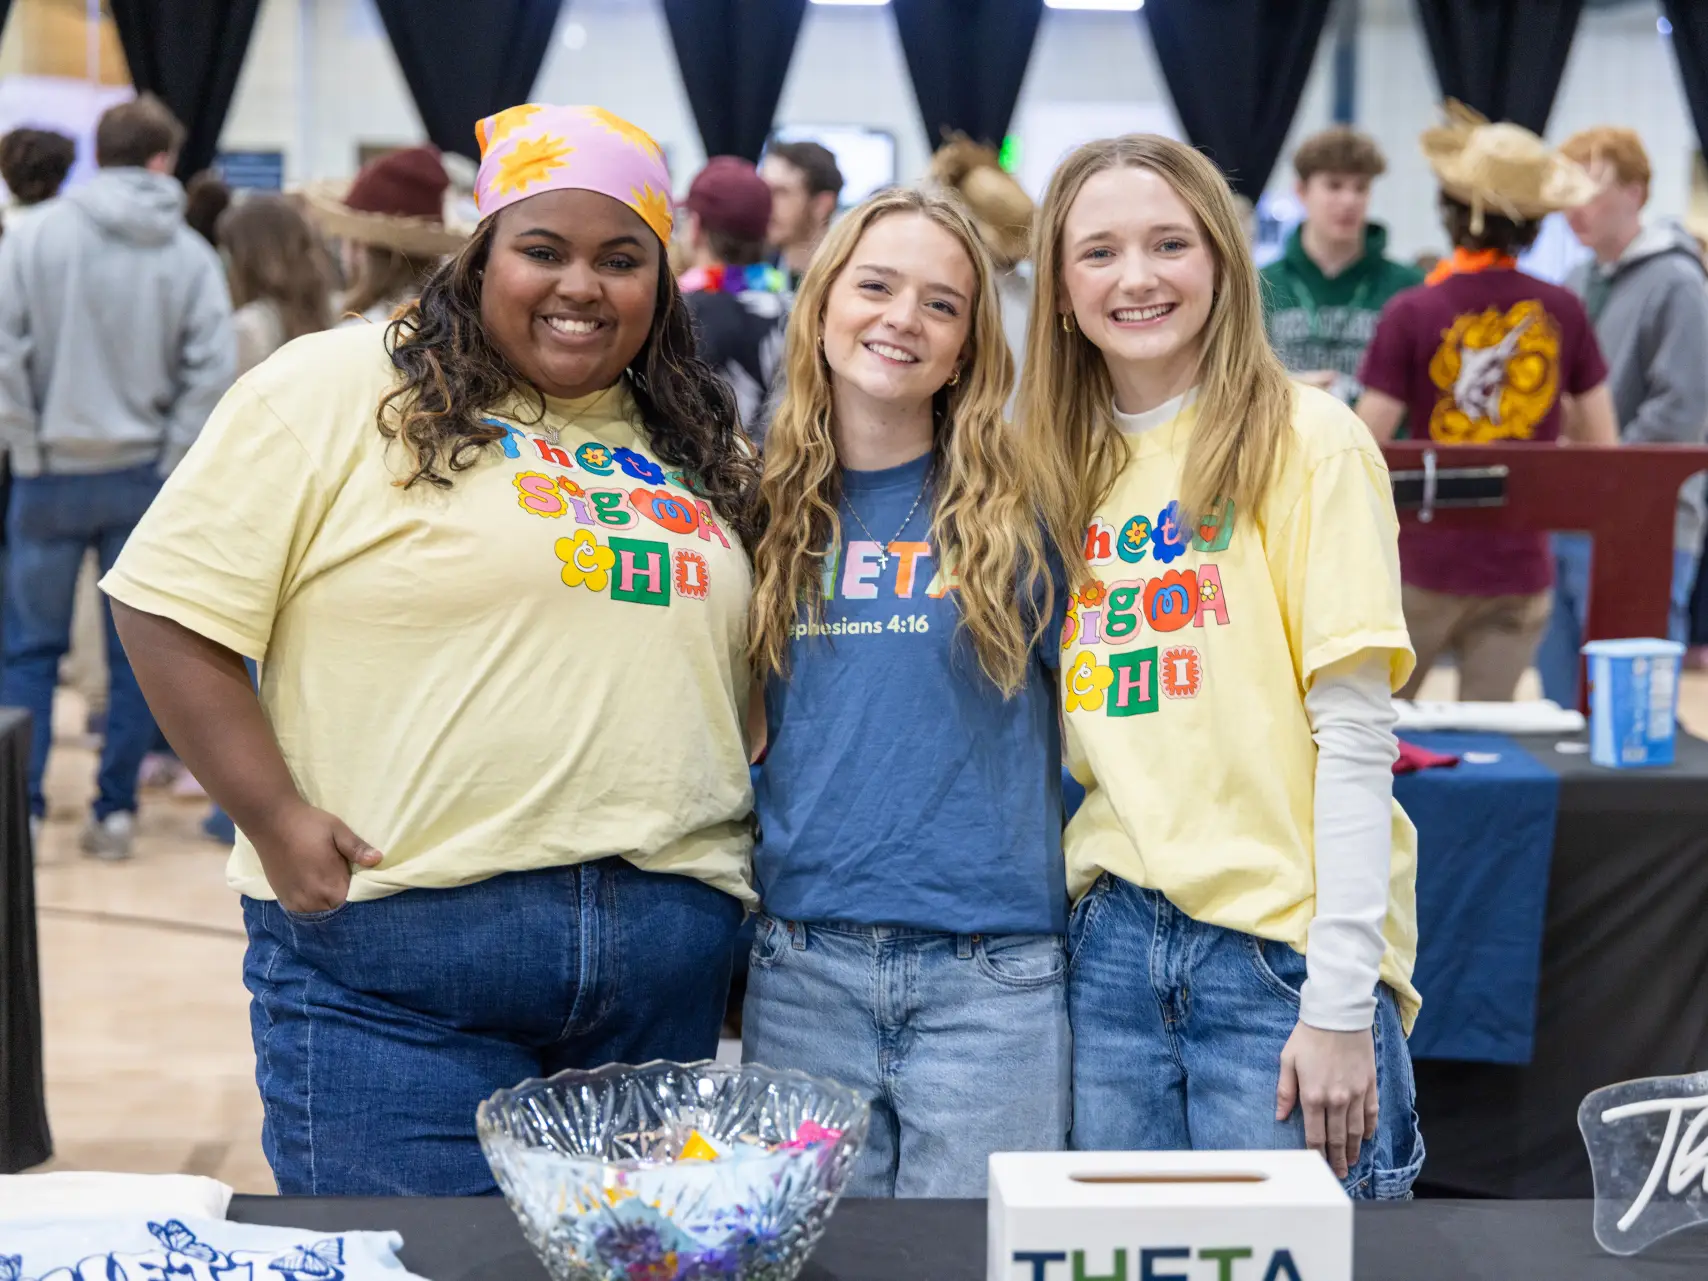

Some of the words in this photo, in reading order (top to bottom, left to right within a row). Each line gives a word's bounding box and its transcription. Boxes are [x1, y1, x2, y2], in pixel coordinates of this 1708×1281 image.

[1082, 496, 1236, 566] heta
[802, 540, 961, 600] ETA
[886, 614, 930, 634] 4:16
